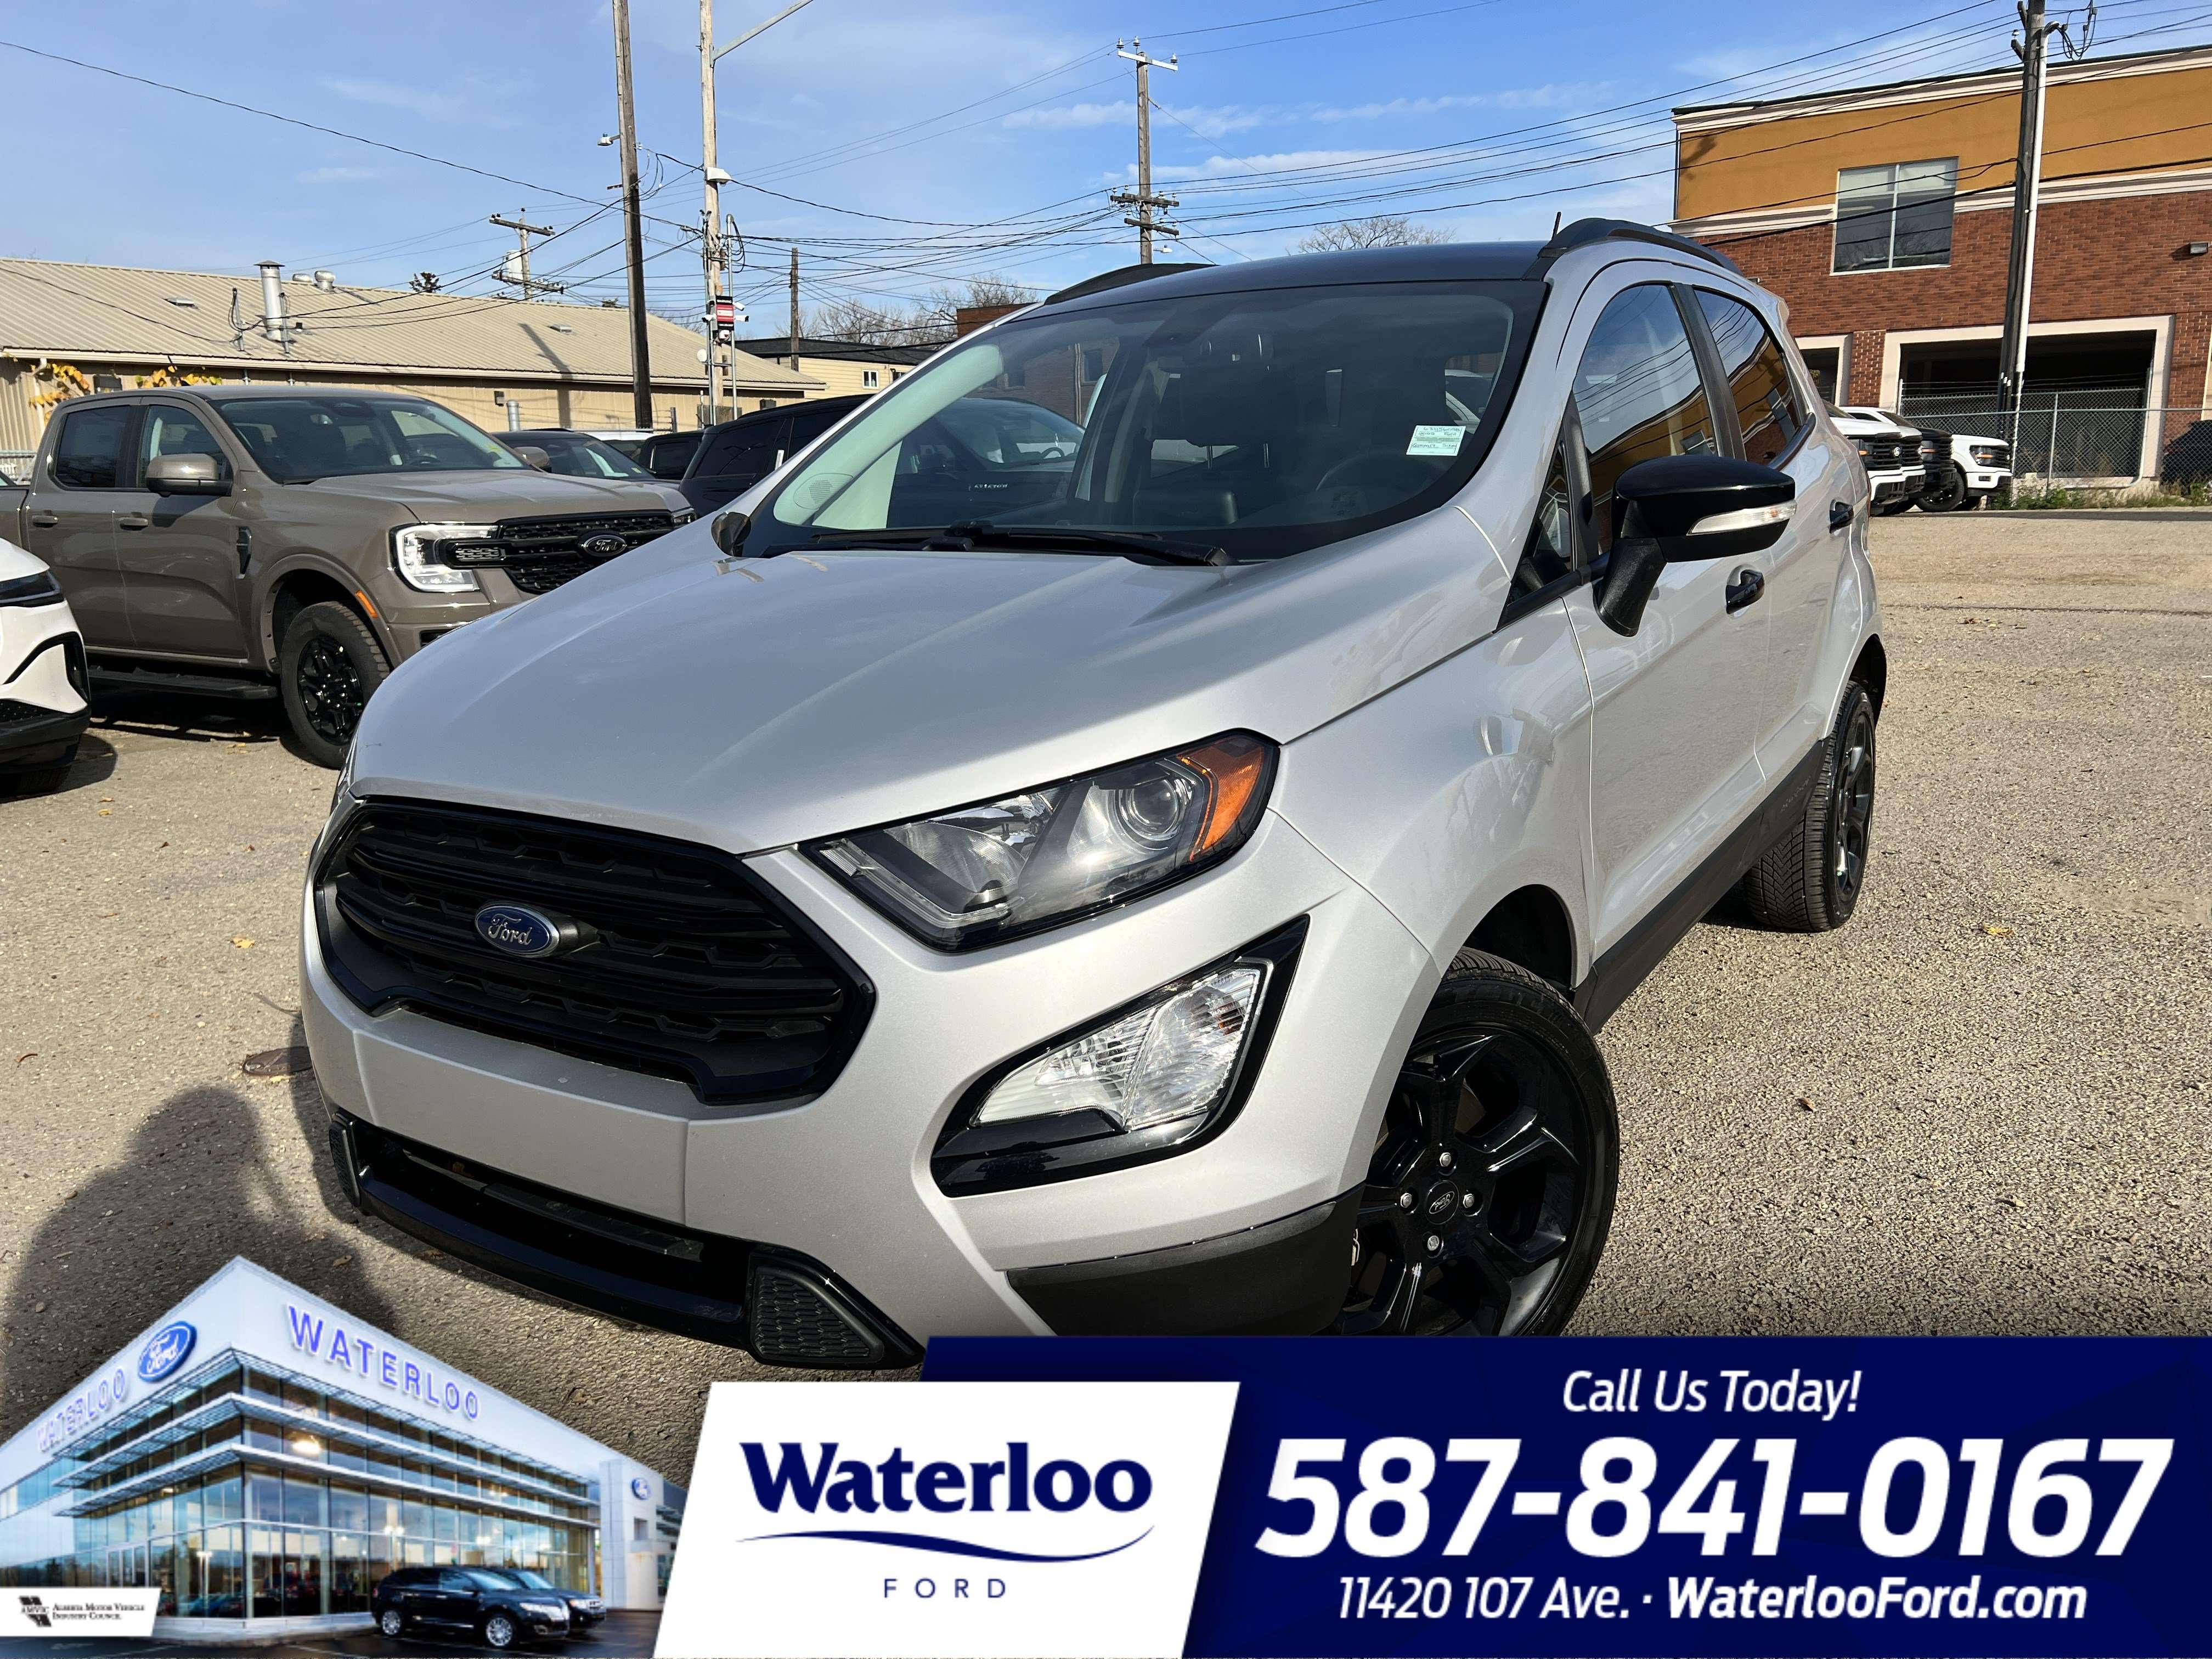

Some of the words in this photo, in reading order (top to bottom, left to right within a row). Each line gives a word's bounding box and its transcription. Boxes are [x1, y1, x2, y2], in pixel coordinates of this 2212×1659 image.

[595, 539, 618, 552] Ford
[488, 913, 532, 945] Ford
[1435, 1194, 1451, 1211] Ford
